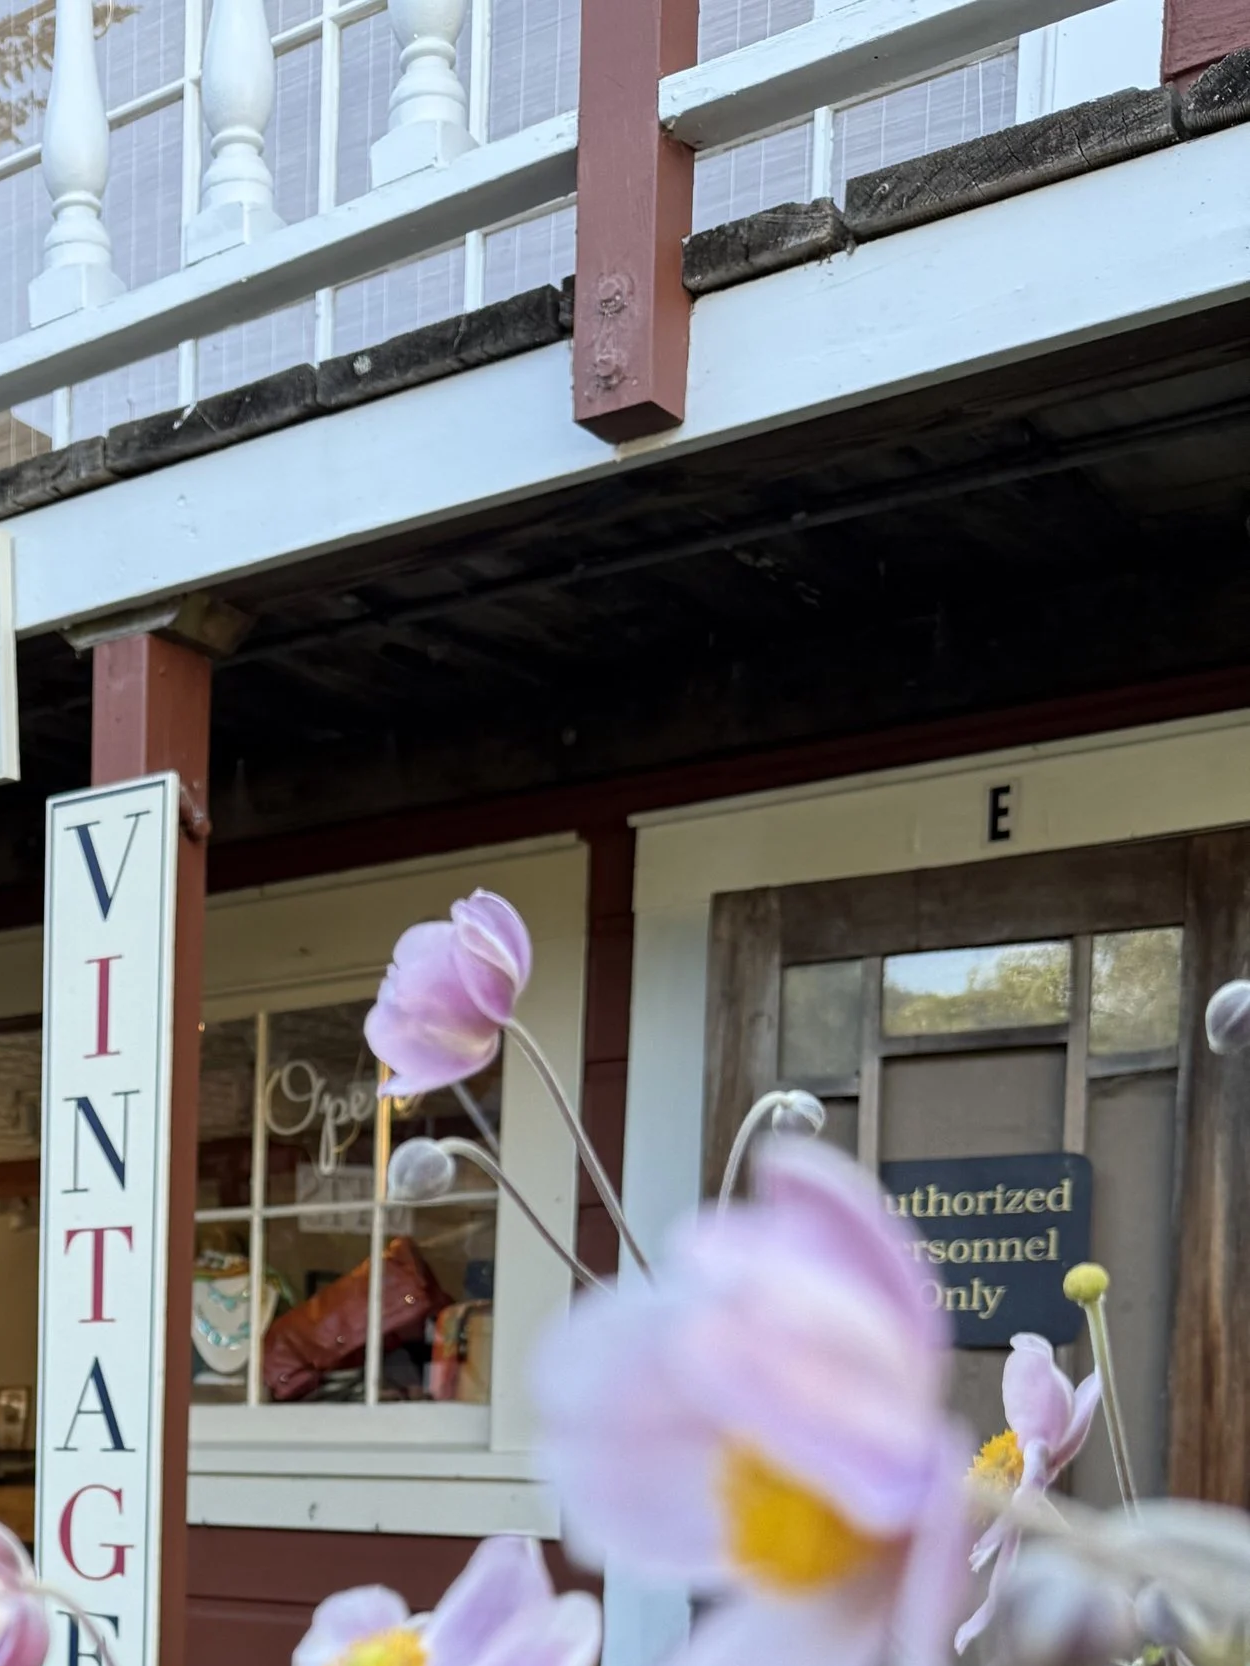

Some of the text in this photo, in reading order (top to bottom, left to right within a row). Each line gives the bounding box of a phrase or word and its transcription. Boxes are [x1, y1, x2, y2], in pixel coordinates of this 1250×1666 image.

[987, 785, 1011, 842] E
[265, 1060, 426, 1176] Ope
[883, 1178, 1074, 1218] uthorized
[910, 1227, 1060, 1264] rsonnel
[920, 1277, 1007, 1320] Only
